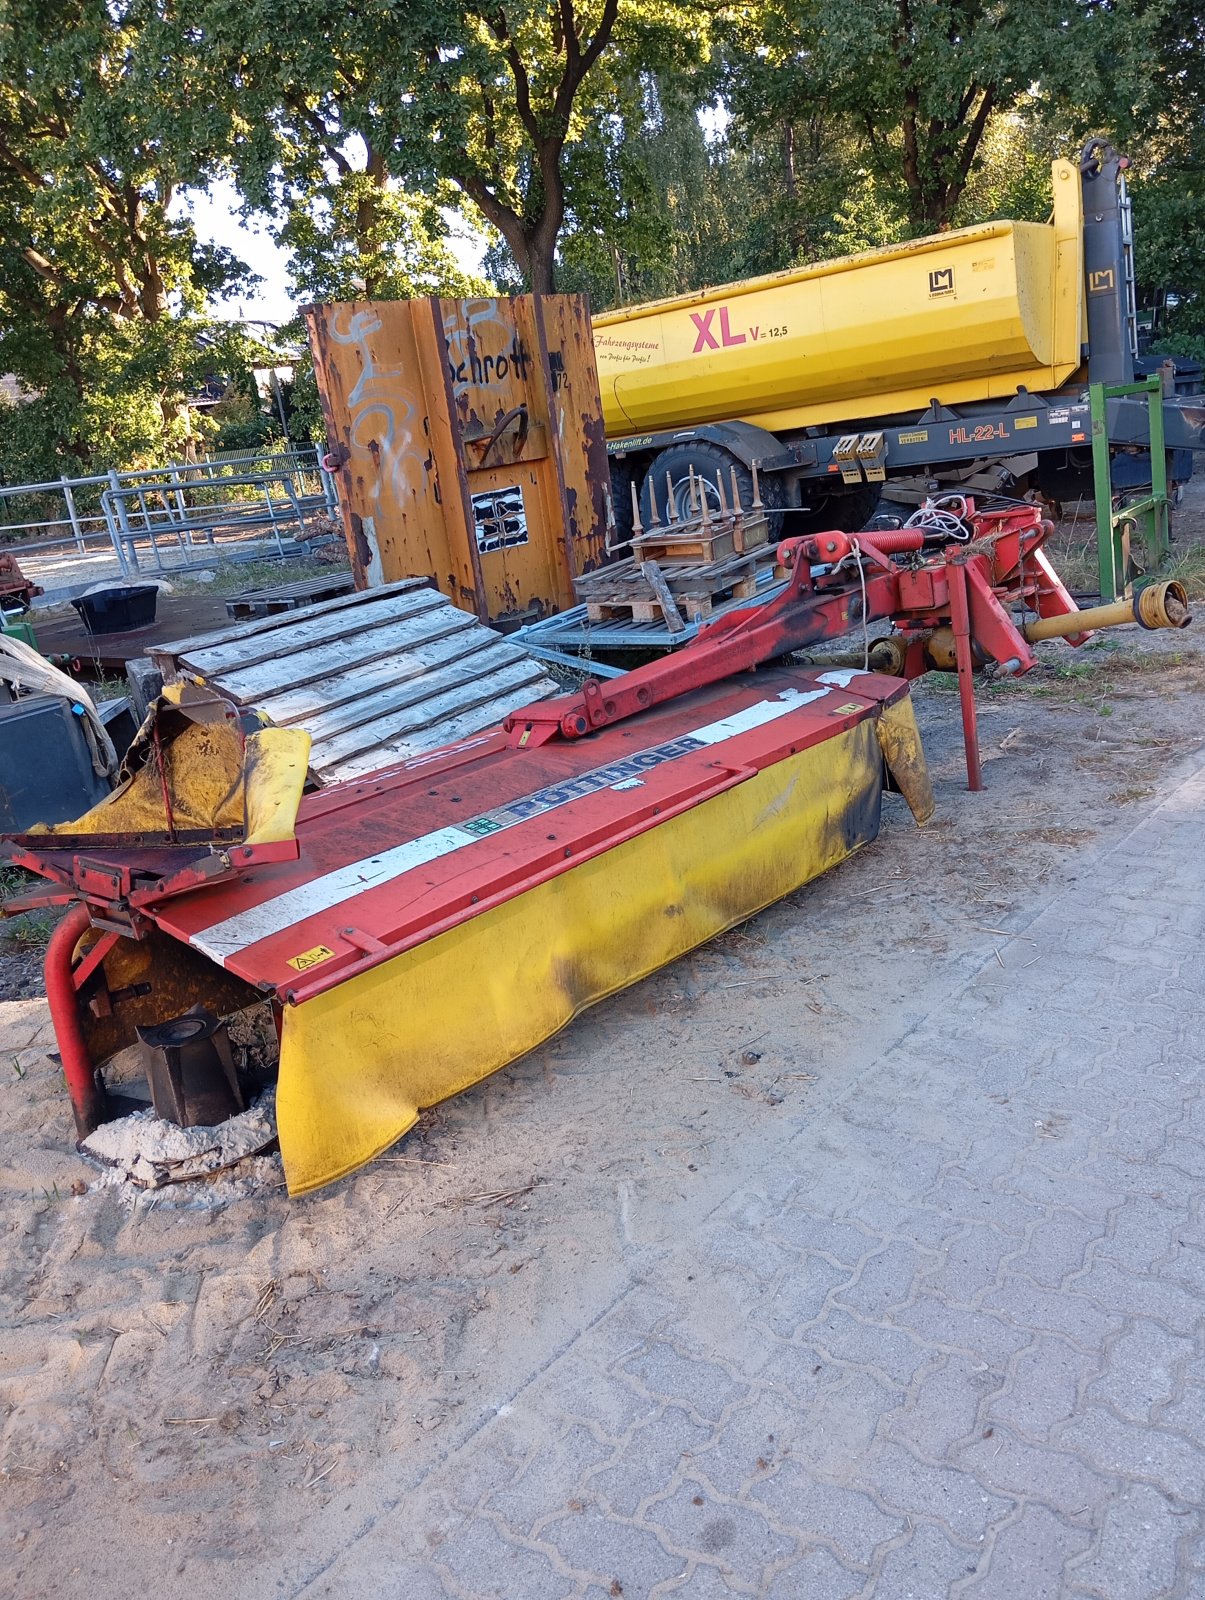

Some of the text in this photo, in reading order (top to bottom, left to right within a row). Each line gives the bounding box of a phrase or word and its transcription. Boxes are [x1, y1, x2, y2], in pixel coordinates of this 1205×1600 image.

[689, 306, 747, 353] XL
[949, 422, 1010, 445] HL-22-L
[506, 735, 707, 817] PÖTTINGER
